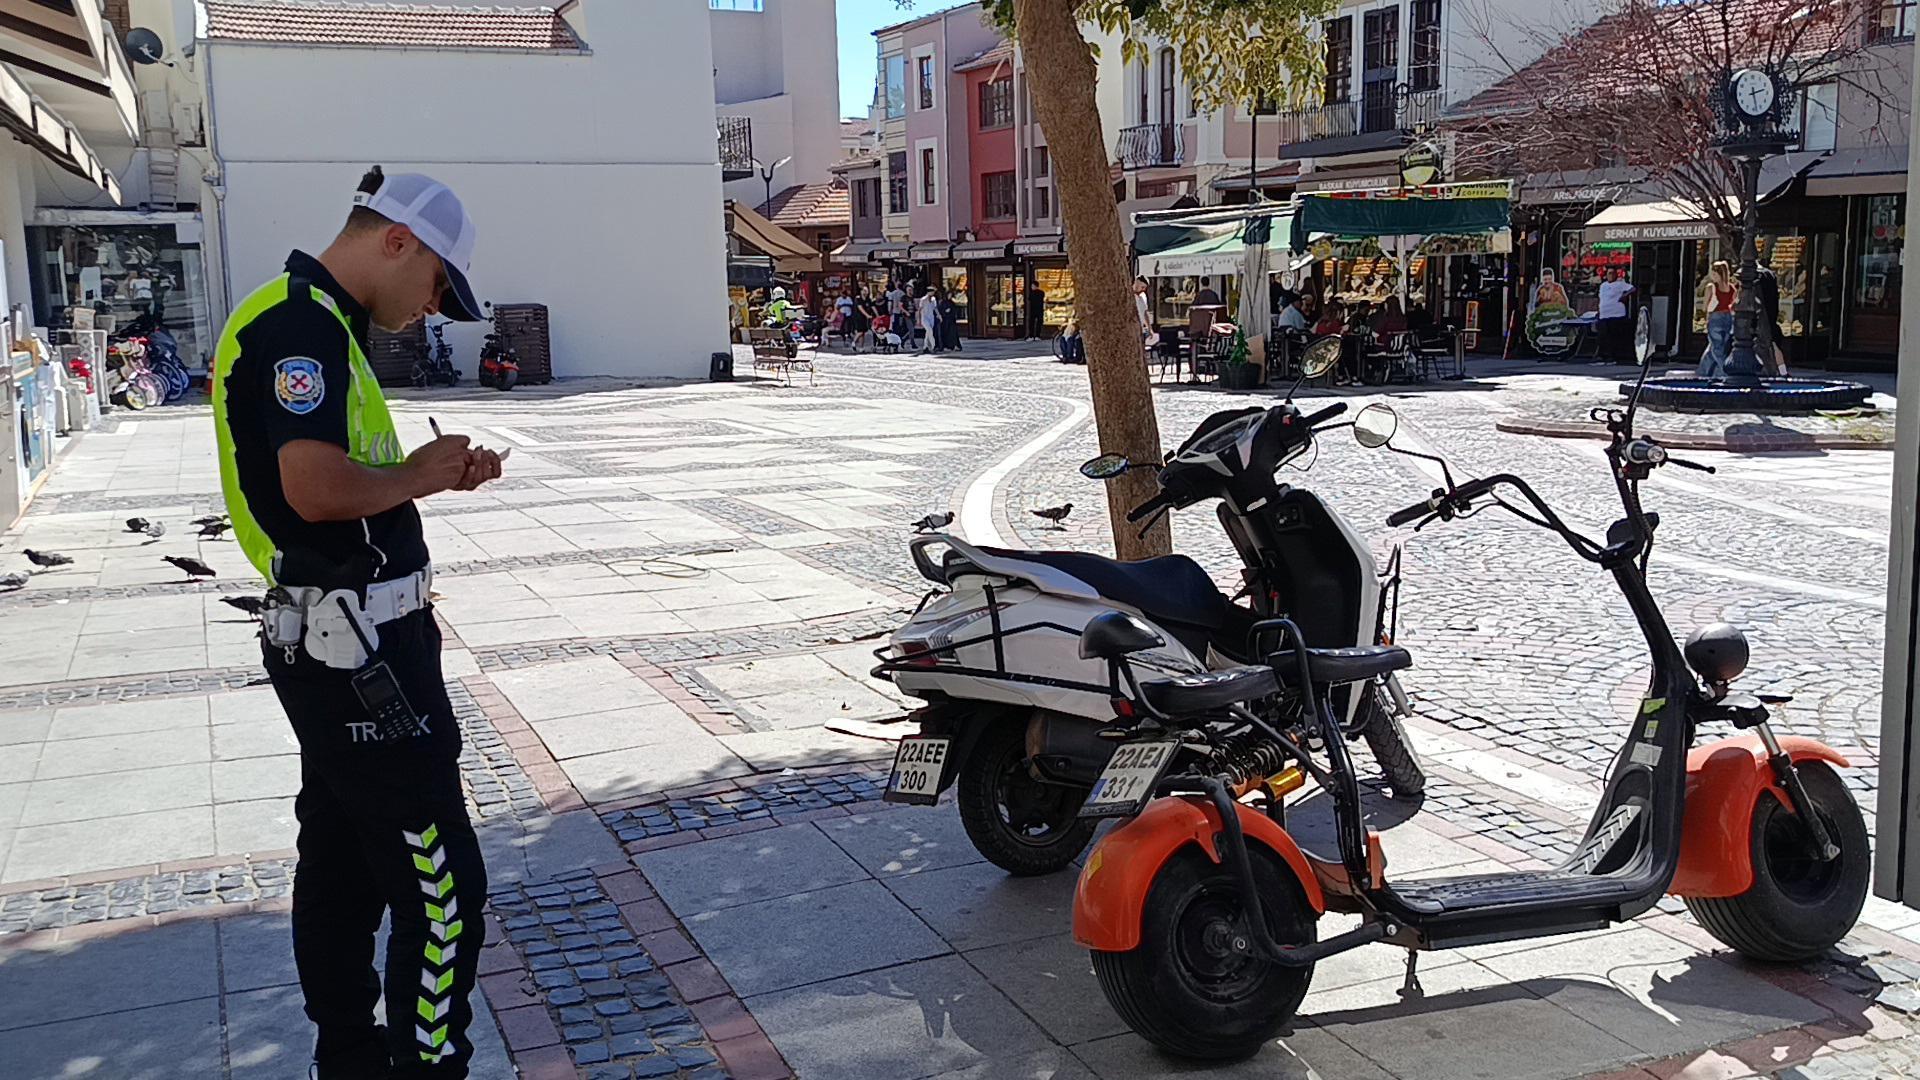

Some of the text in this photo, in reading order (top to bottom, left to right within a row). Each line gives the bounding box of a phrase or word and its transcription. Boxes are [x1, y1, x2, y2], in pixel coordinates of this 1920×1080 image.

[1604, 225, 1708, 239] SERHAT KUYUMCULUK
[345, 714, 431, 742] TRK
[900, 743, 945, 764] 22AEE
[1109, 747, 1166, 769] 22AEA
[901, 770, 927, 791] 300
[1102, 776, 1138, 798] 331
